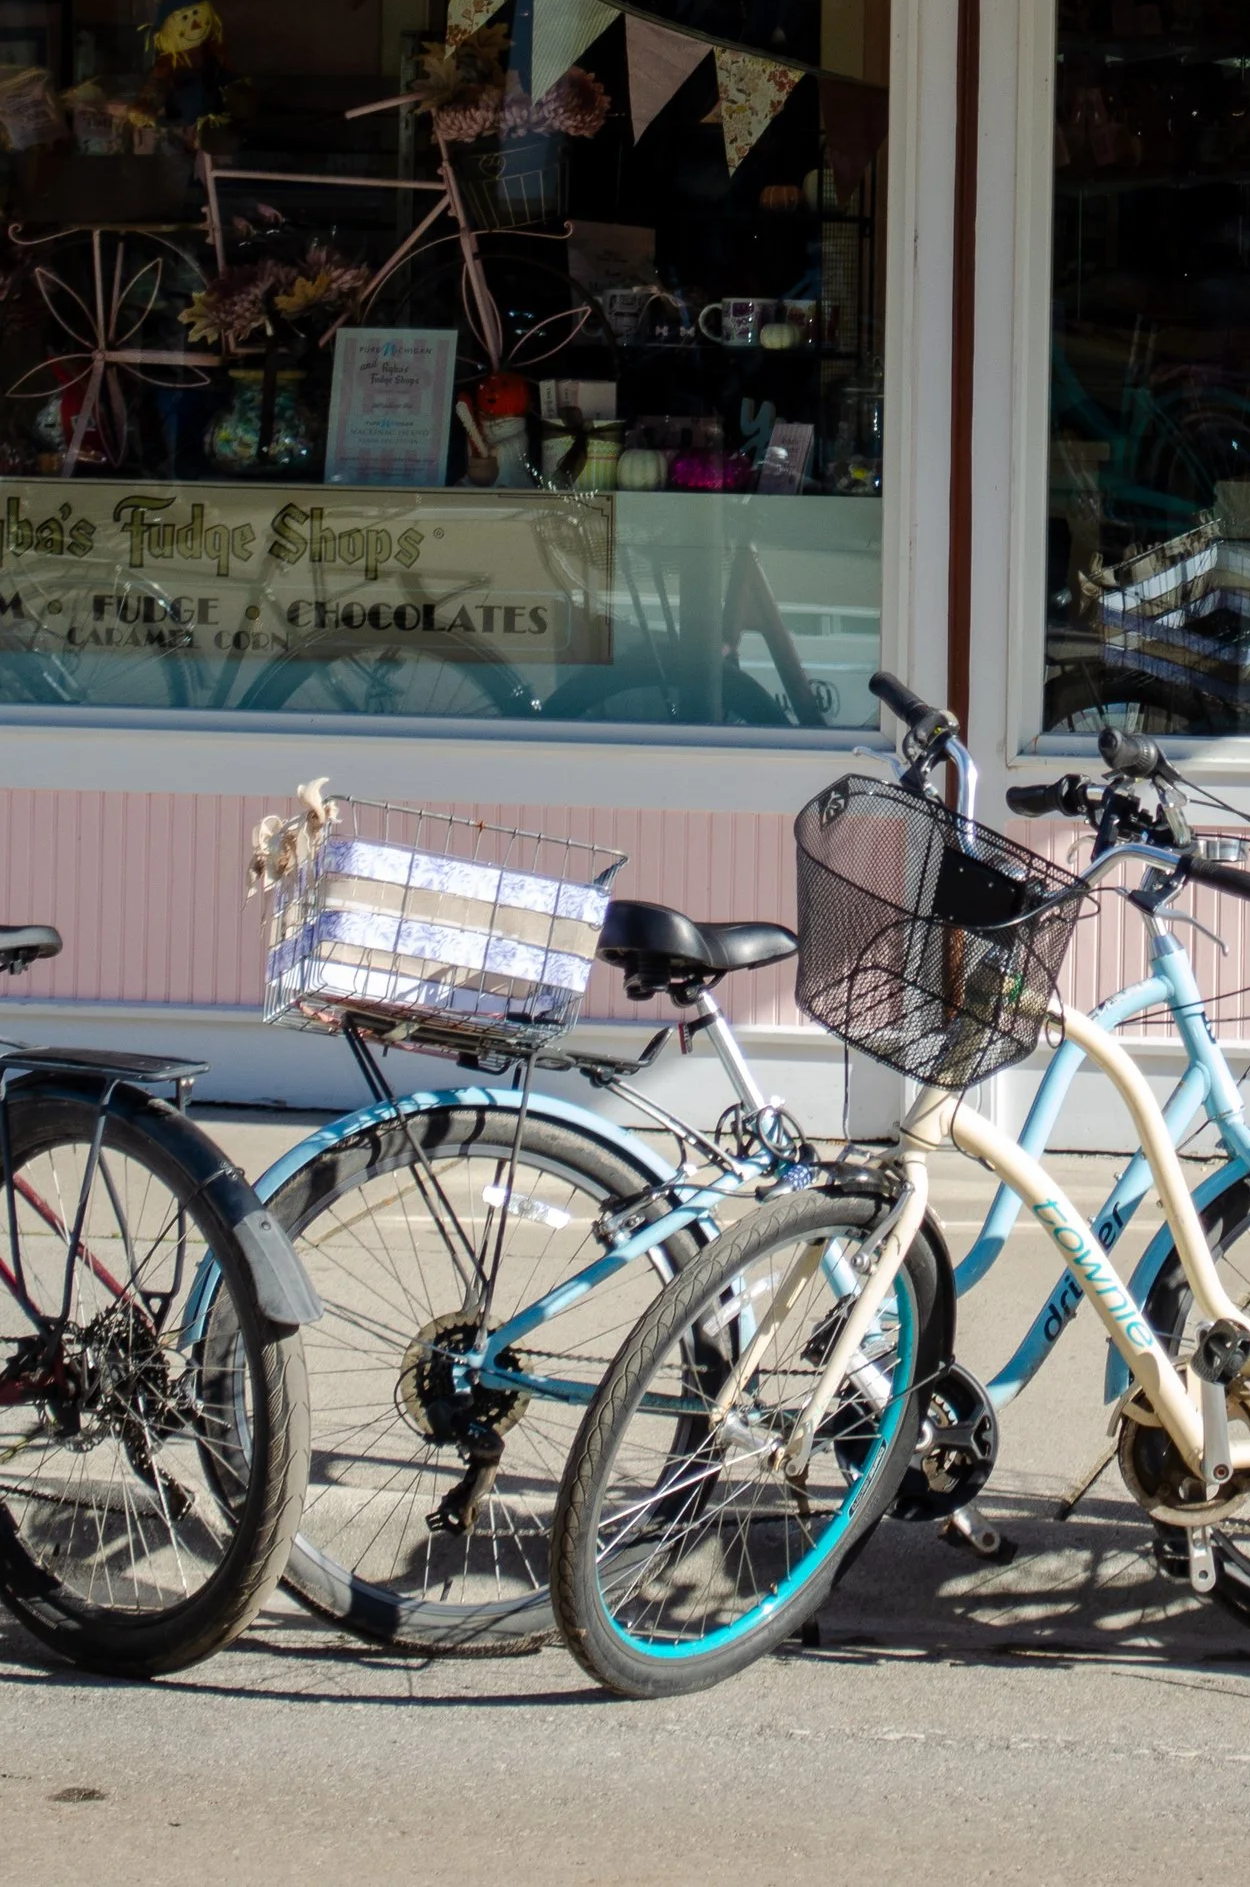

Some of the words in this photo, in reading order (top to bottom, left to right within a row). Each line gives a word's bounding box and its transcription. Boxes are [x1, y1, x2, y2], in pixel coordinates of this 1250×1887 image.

[113, 495, 256, 577] Fudge
[93, 594, 219, 626] FUDGE
[287, 599, 548, 635] CHOCOLATES
[214, 631, 290, 651] CORN
[1032, 1198, 1153, 1348] townie
